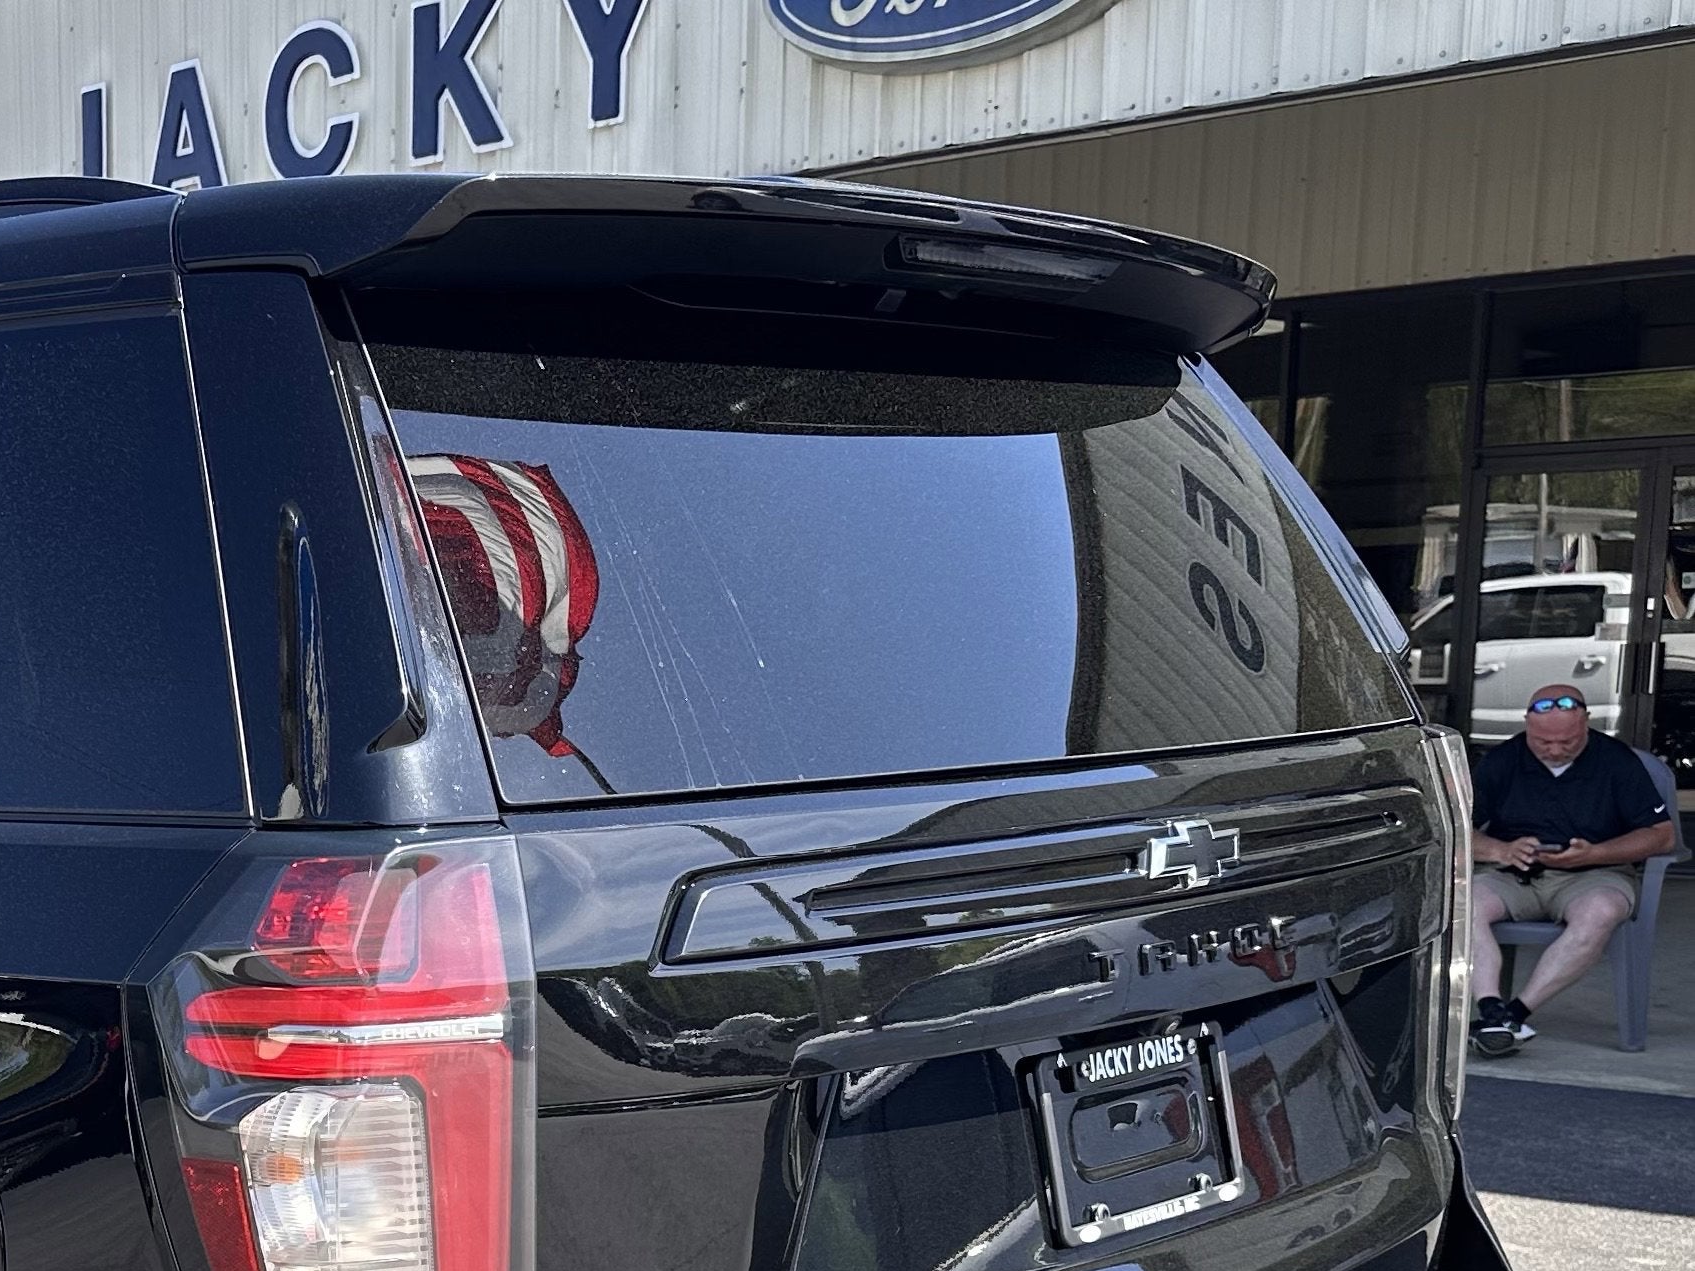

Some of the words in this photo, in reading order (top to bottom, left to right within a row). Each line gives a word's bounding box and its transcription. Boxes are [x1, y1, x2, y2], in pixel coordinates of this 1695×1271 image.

[1088, 915, 1297, 983] TAHOE
[381, 1023, 479, 1040] CHEVROLET
[1088, 1044, 1133, 1082] JACKY
[1137, 1034, 1184, 1071] JONES
